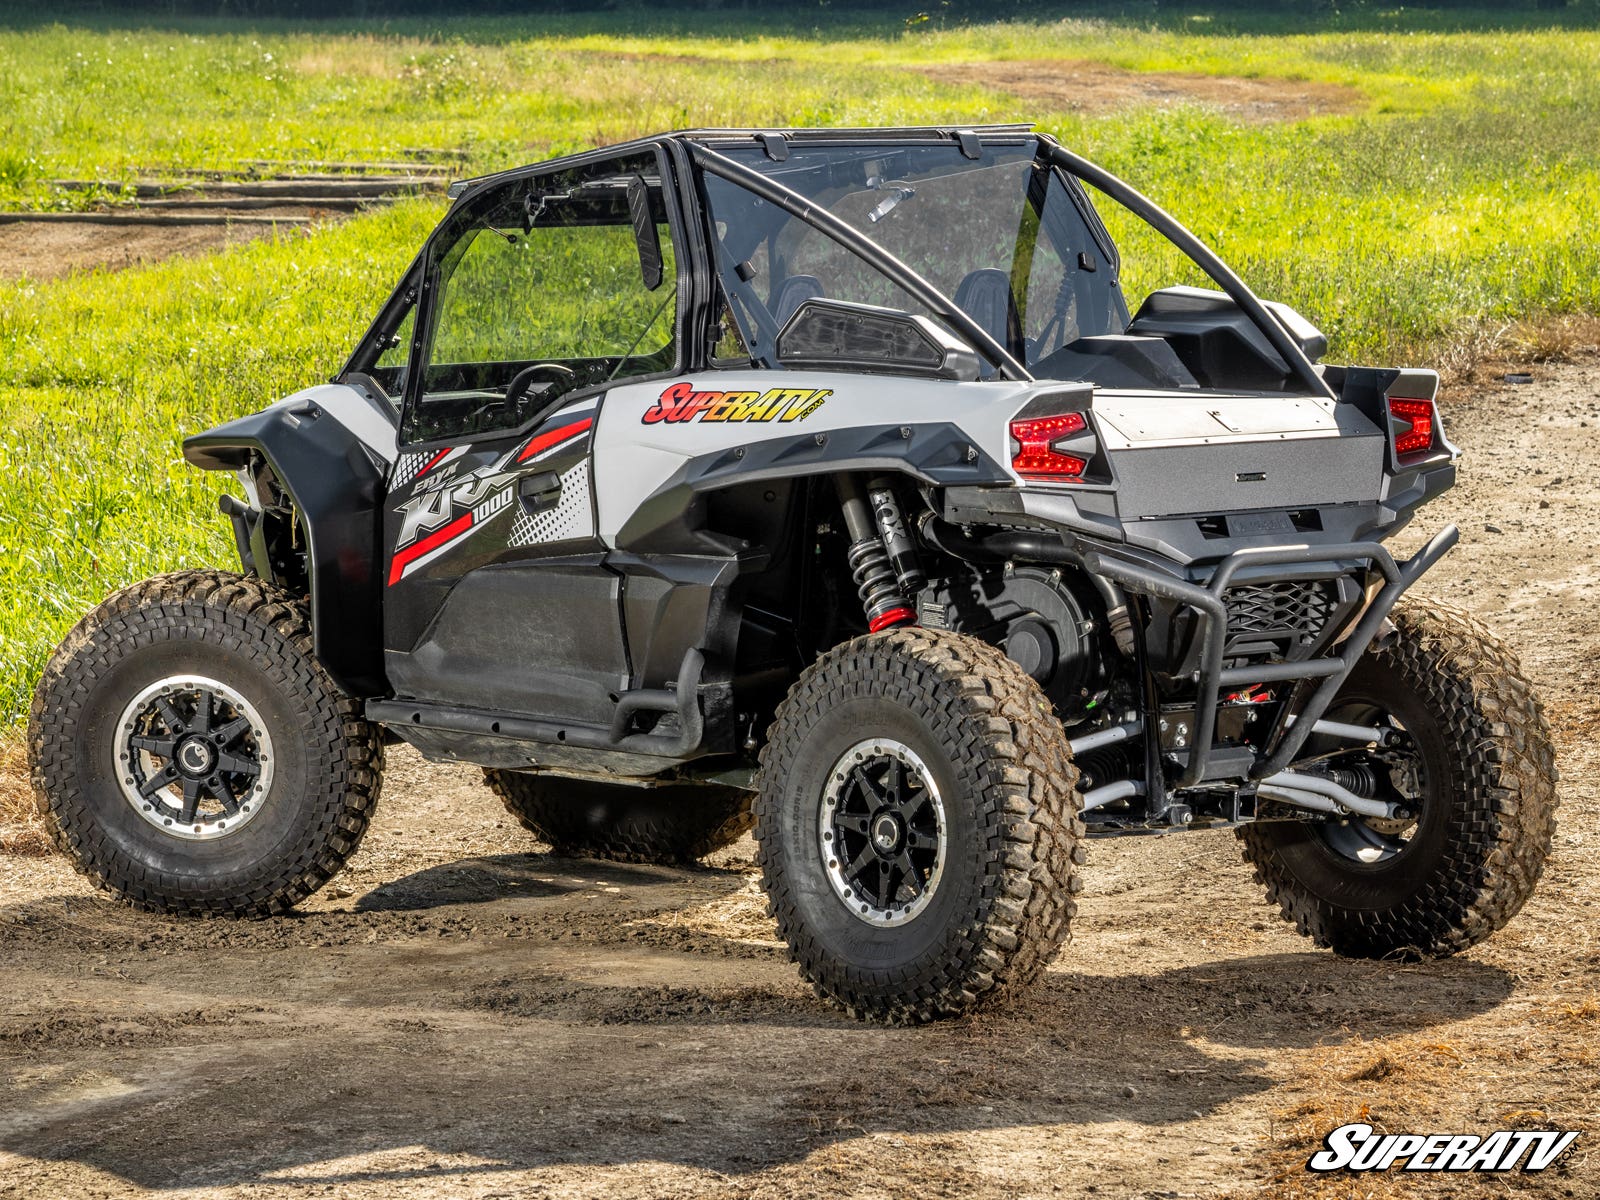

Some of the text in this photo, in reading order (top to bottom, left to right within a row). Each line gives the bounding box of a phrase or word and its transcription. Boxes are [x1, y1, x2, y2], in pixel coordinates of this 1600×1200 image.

[641, 382, 833, 425] SUPERATV
[393, 441, 534, 552] KRX
[410, 461, 460, 496] ERYX
[472, 486, 513, 525] 1000
[873, 490, 907, 544] FOX
